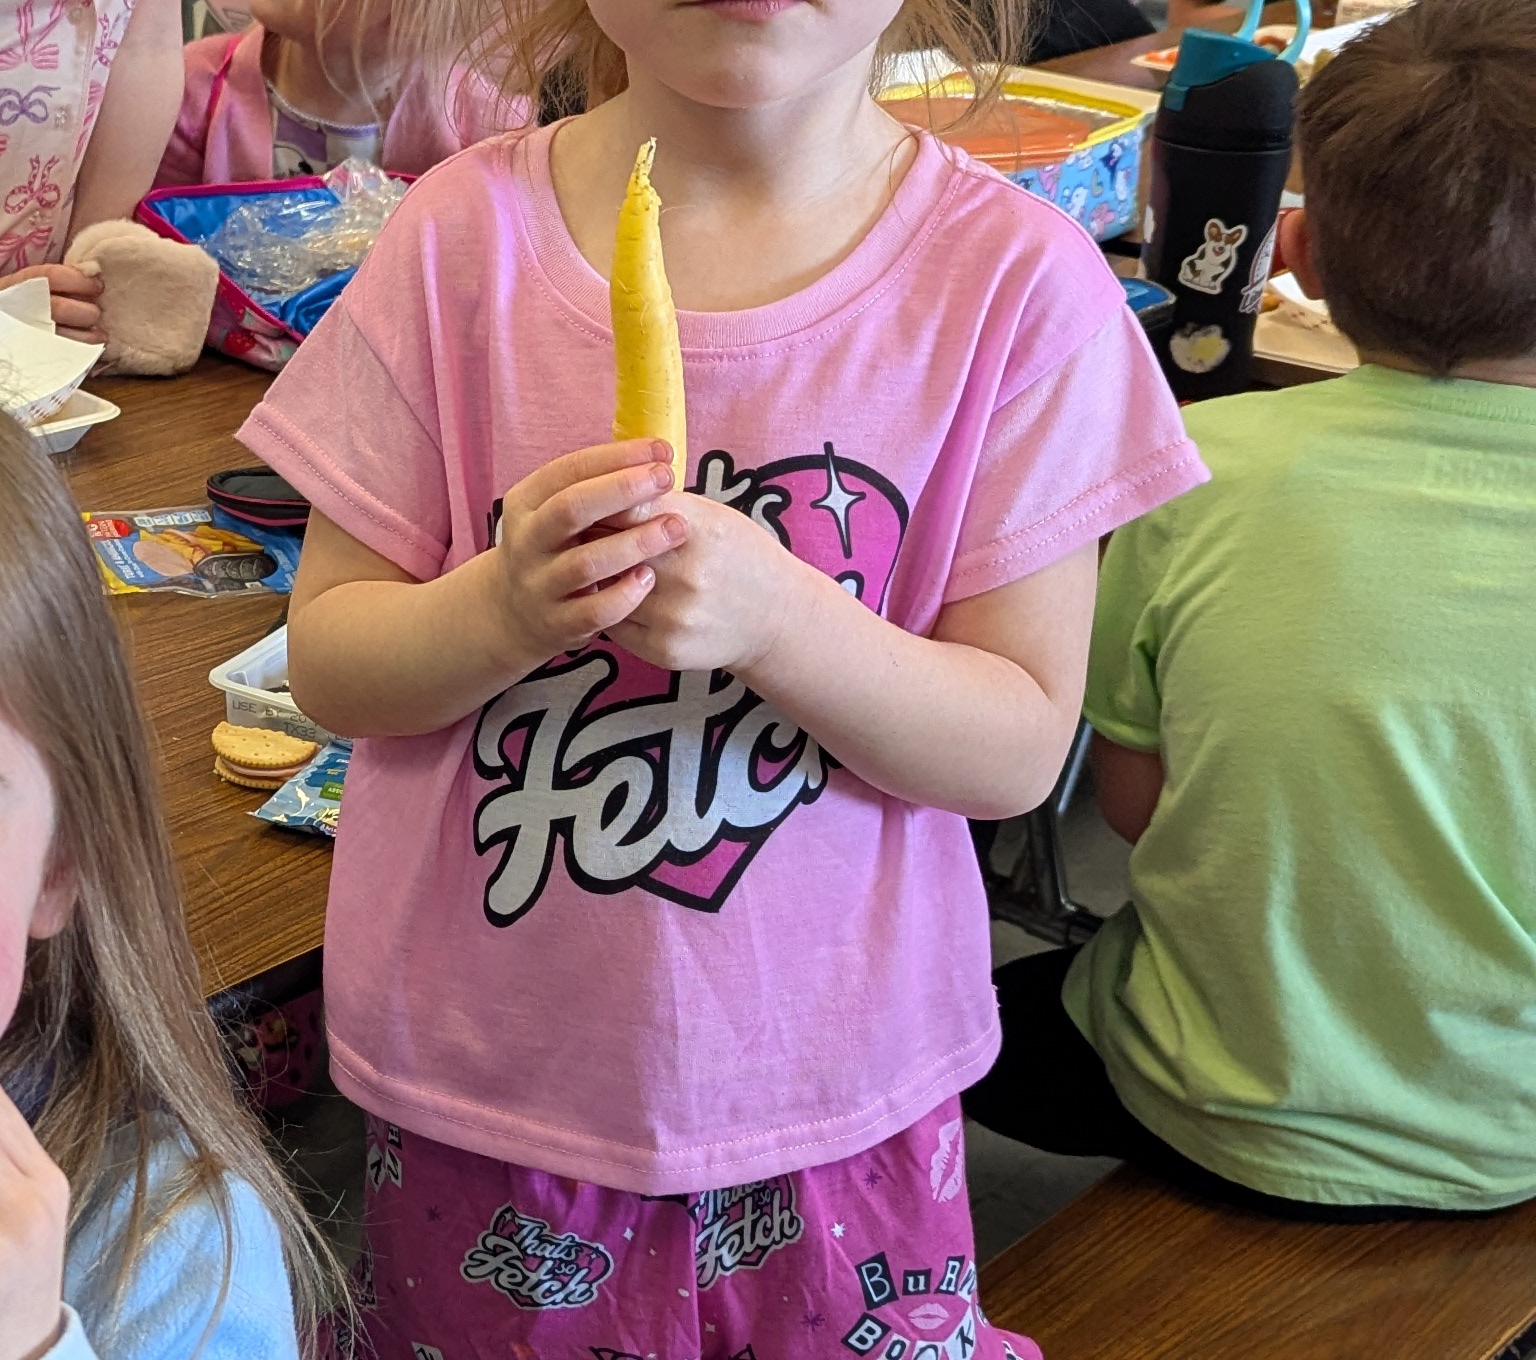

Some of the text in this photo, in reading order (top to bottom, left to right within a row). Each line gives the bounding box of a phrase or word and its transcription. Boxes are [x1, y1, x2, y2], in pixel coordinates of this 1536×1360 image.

[232, 700, 257, 714] USE
[474, 650, 828, 927] Fetc
[465, 1236, 595, 1305] Fetch
